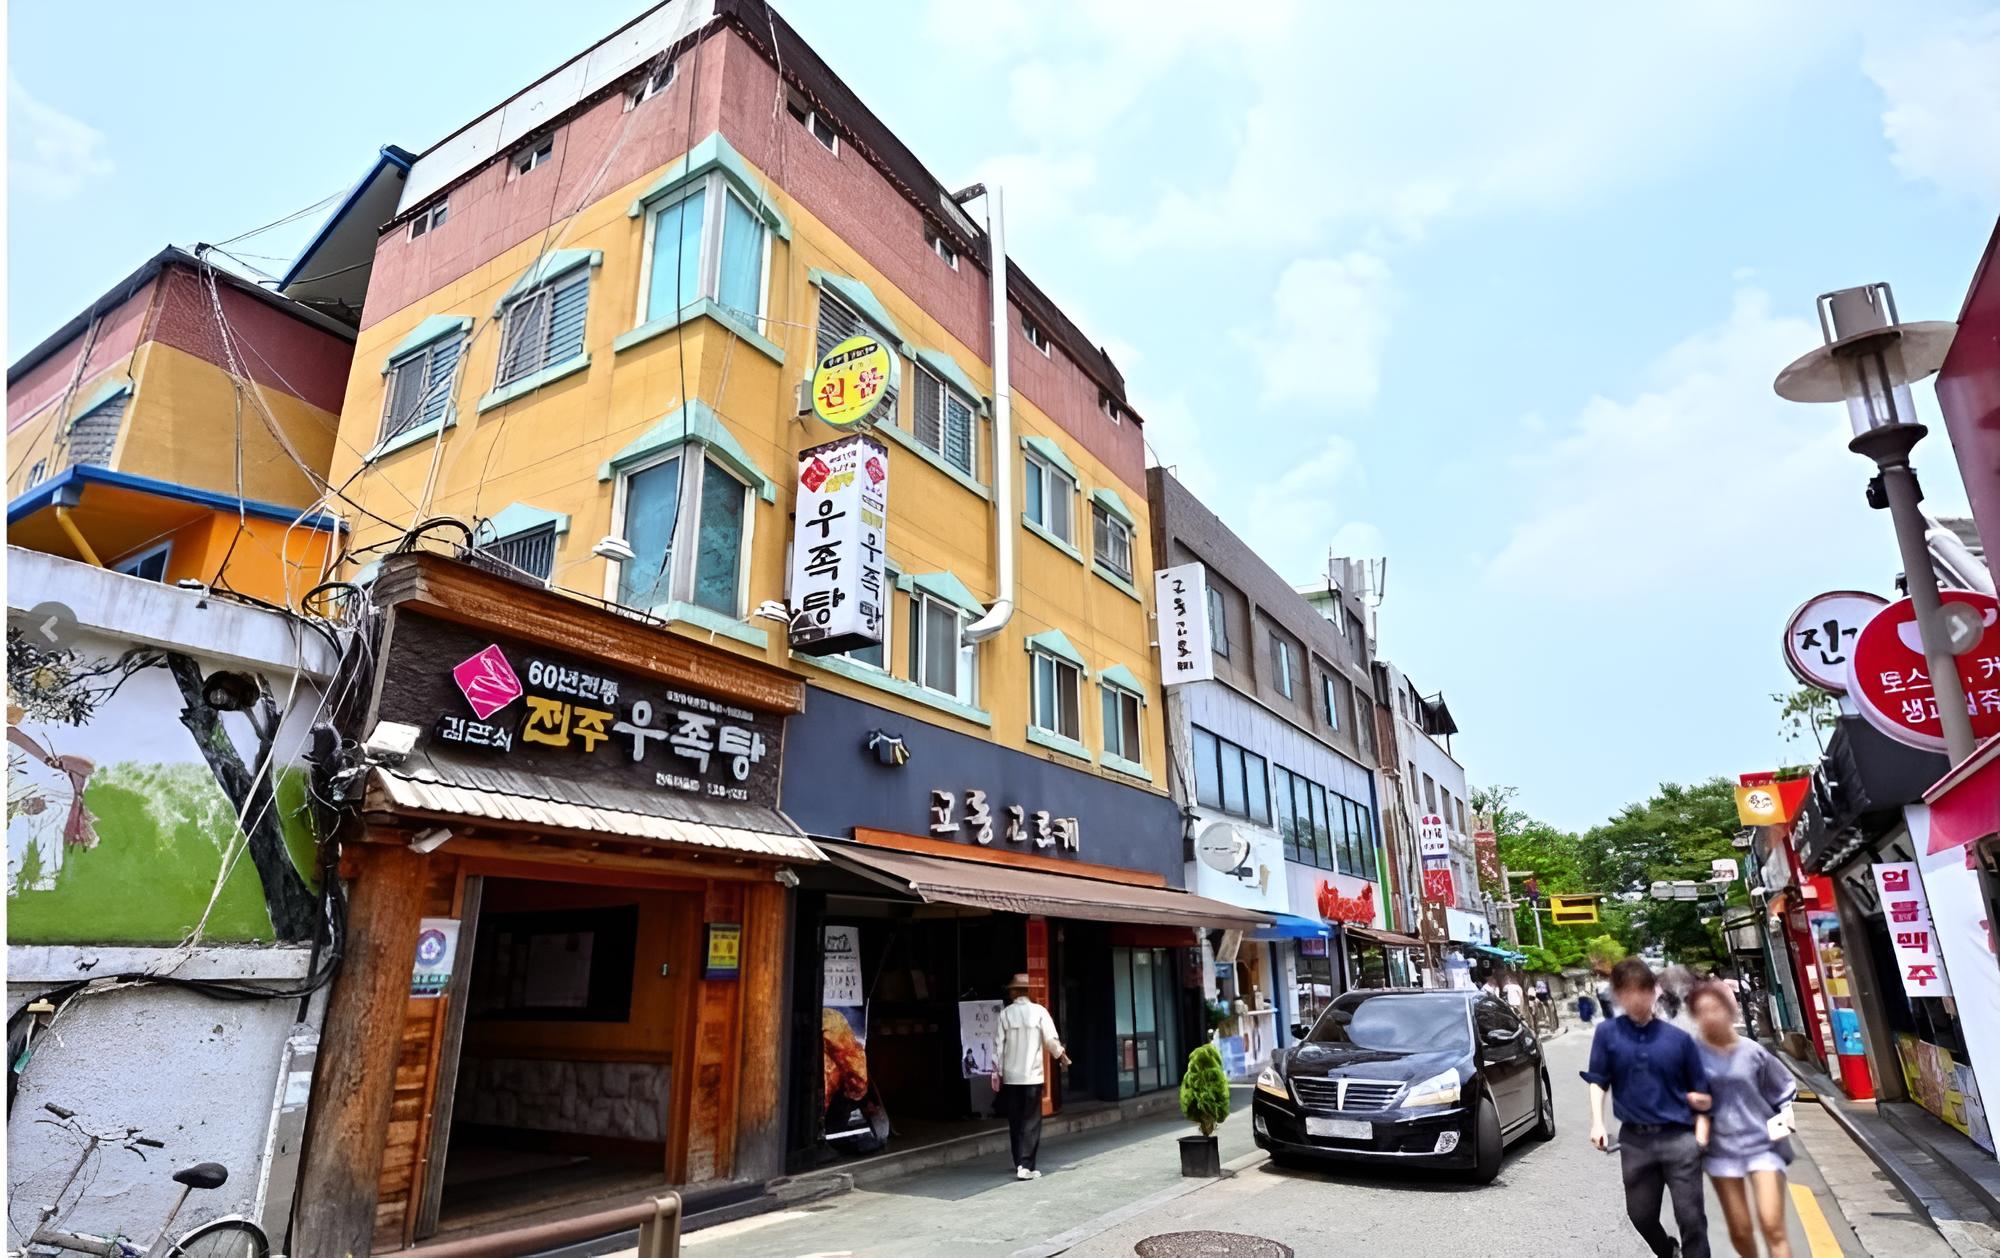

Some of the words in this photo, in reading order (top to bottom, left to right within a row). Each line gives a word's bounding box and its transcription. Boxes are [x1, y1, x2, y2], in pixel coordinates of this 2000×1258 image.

[804, 499, 846, 626] 우족탕
[860, 532, 884, 632] 우족탕
[1796, 619, 1858, 666] 진
